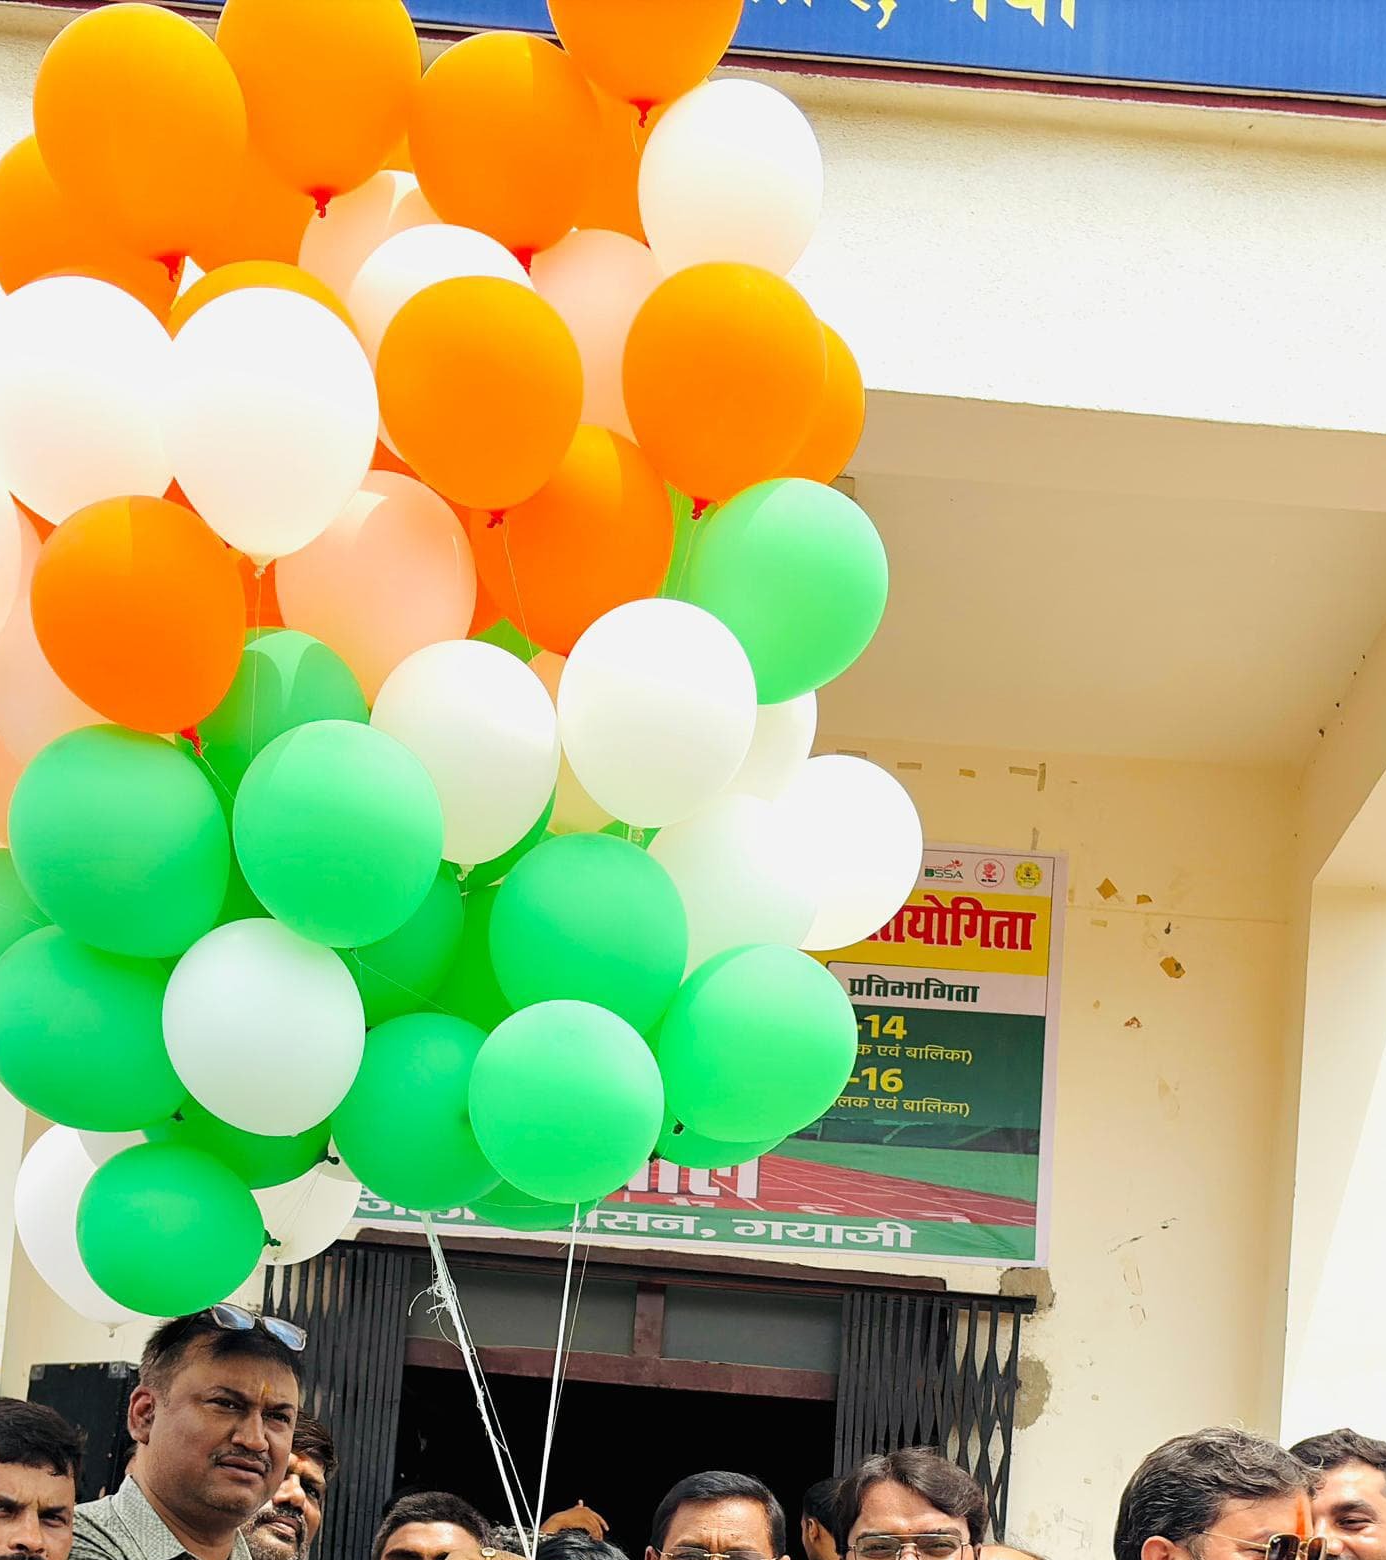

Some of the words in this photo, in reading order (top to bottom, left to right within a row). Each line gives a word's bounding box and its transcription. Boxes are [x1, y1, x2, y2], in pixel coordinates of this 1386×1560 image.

[877, 1043, 900, 1057] एवं
[873, 1096, 897, 1110] एवं
[732, 1219, 917, 1248] गयाजी
